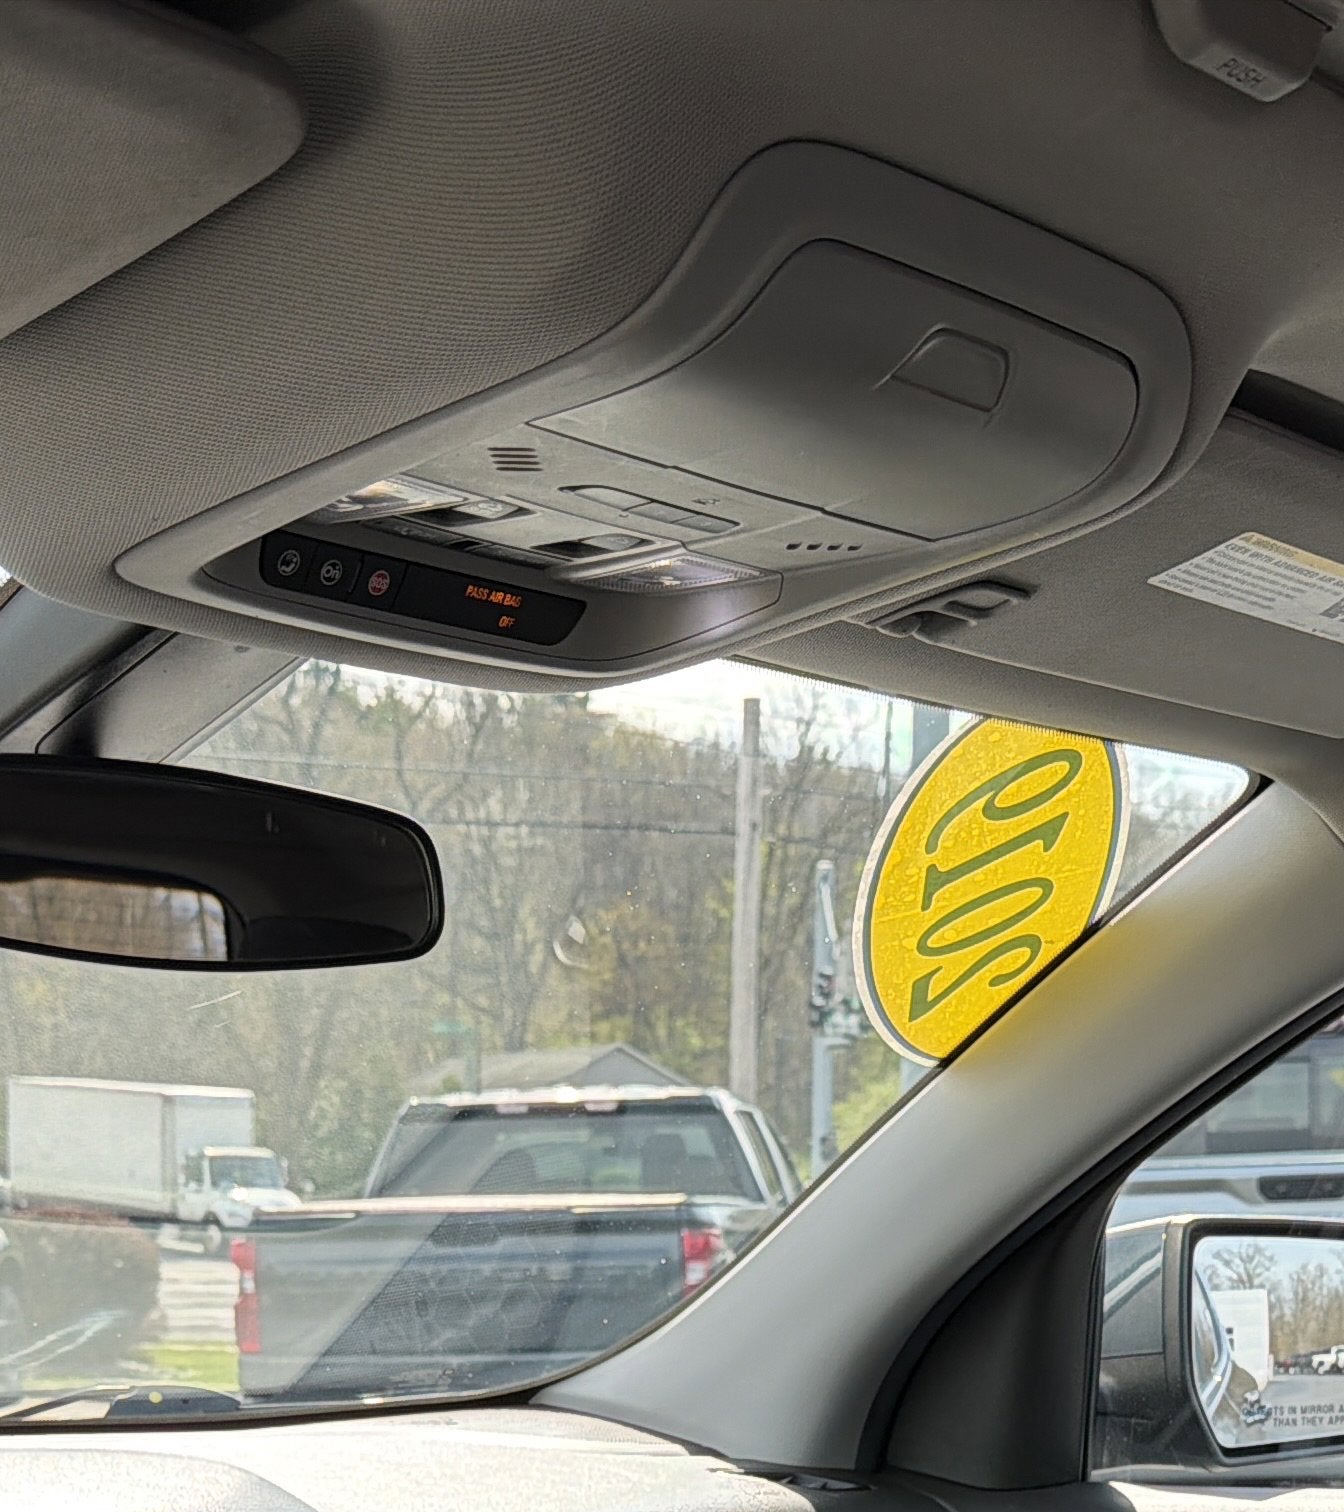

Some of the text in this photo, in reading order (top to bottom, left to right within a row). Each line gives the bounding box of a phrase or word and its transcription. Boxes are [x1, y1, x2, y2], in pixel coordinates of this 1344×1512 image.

[1216, 57, 1268, 88] PUSH
[464, 584, 522, 607] PASS AIR BAG
[498, 615, 516, 628] OFF
[1287, 1403, 1297, 1415] IN
[1300, 1402, 1335, 1415] MIRROR
[1272, 1416, 1298, 1428] THAN
[1300, 1415, 1324, 1427] THEY
